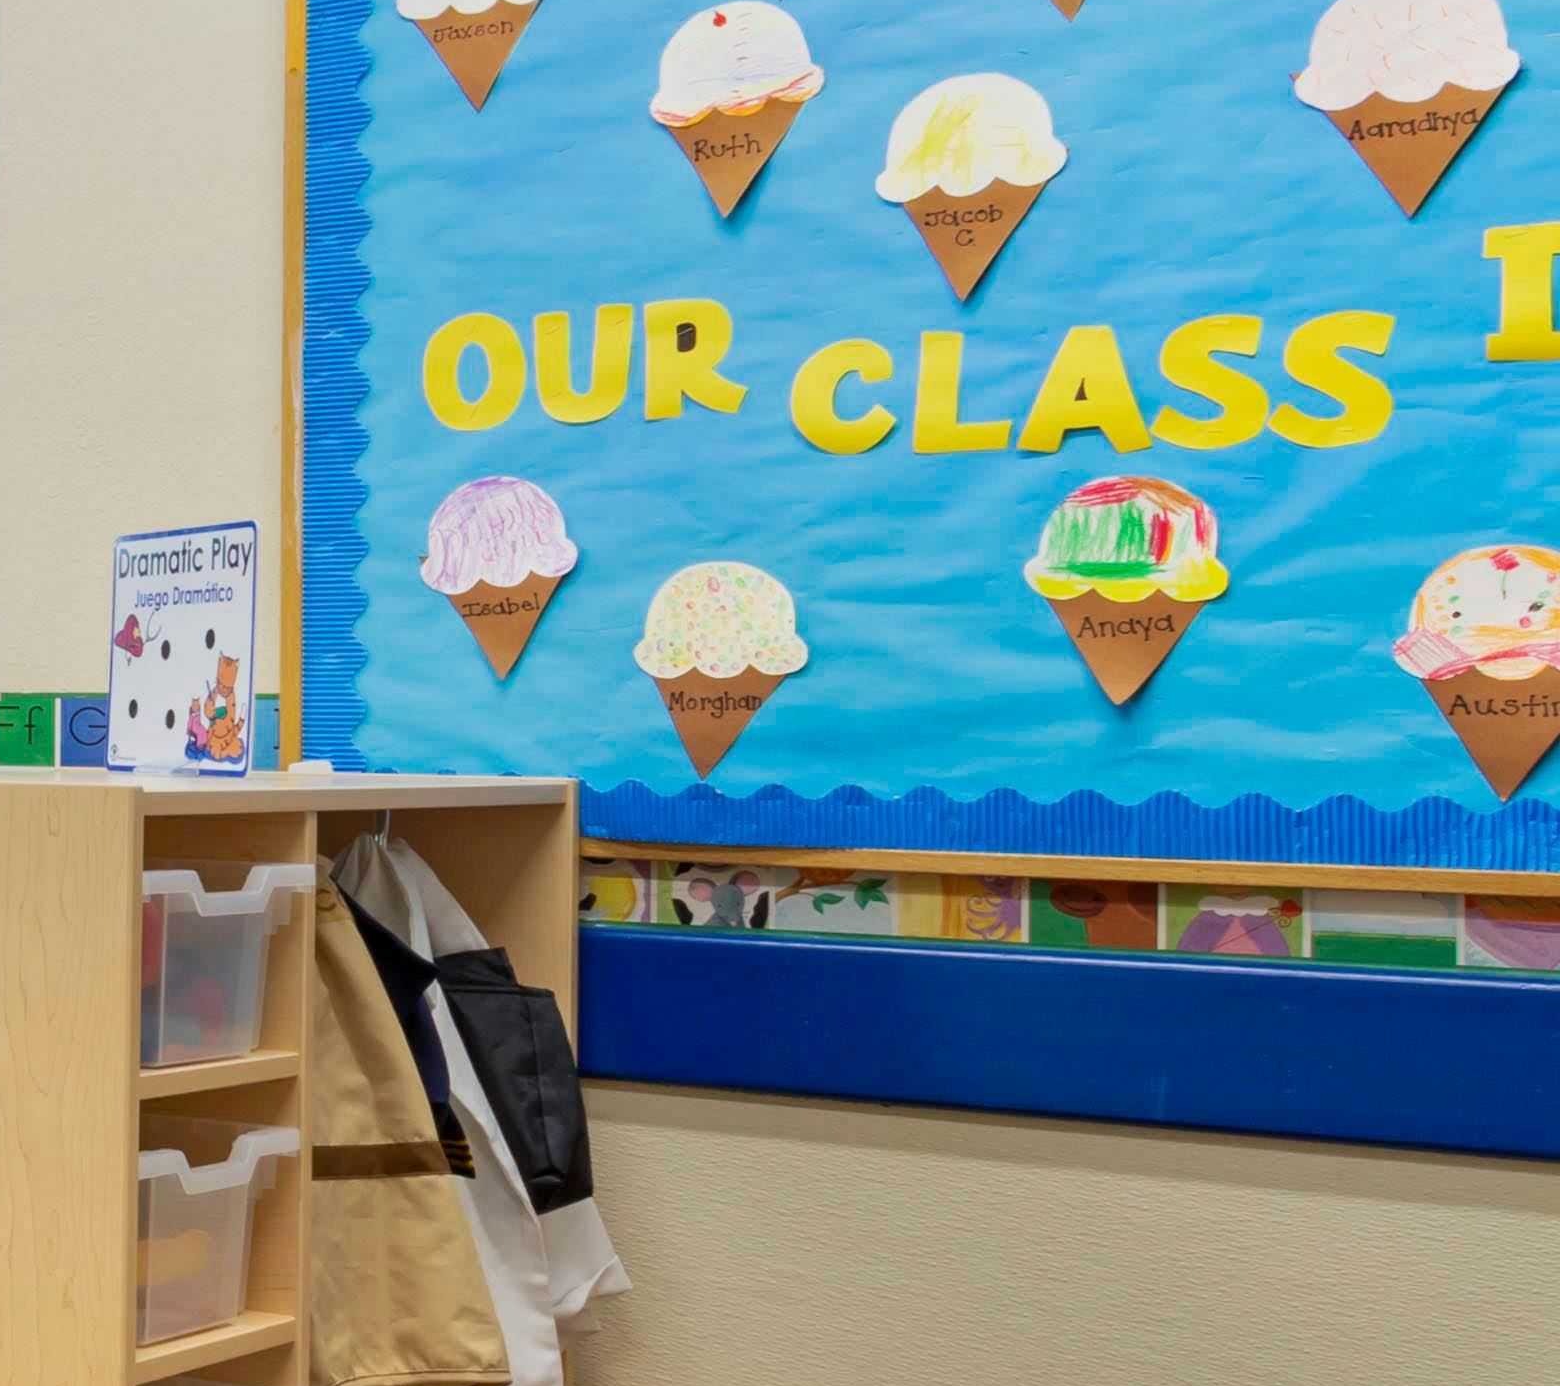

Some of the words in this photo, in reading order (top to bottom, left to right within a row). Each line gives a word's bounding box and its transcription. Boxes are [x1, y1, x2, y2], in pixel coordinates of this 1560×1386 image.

[432, 19, 516, 44] Jaxson
[1348, 105, 1482, 142] Aaradhya
[693, 133, 763, 162] Ruth
[924, 203, 1004, 228] Jacob
[420, 296, 750, 431] OUR
[790, 310, 1397, 455] CLASS
[118, 537, 204, 579] Dramatic
[211, 535, 254, 577] Play
[133, 587, 170, 612] Juego
[172, 580, 234, 606] Dramático
[462, 592, 542, 618] Isabel
[1076, 613, 1176, 641] Anaya
[669, 690, 763, 719] Morghan
